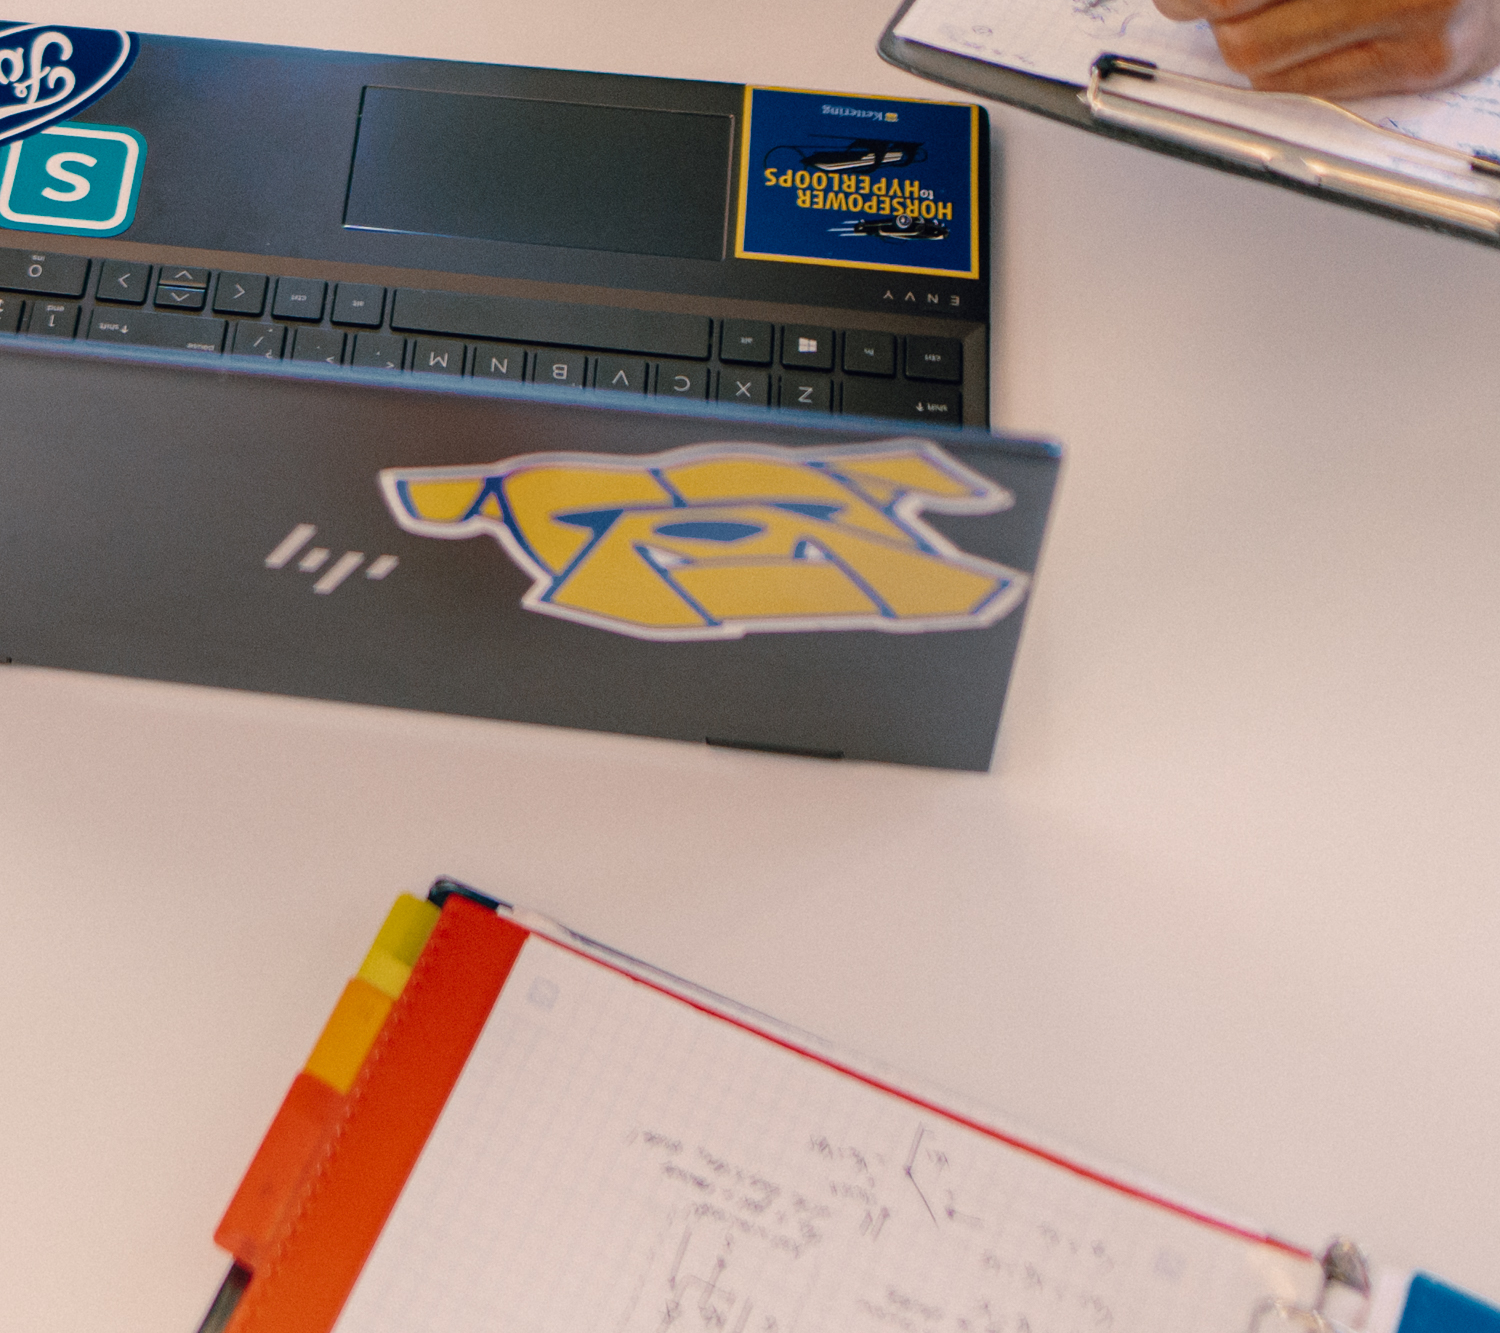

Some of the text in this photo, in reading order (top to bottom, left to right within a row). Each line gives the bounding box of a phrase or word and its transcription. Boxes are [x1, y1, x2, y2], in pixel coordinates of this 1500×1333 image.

[822, 104, 883, 122] Kettering
[41, 152, 97, 202] S
[764, 168, 934, 200] to HYPERLOOPS
[796, 190, 952, 220] HORSEPOWER
[883, 290, 960, 306] ENVY
[428, 351, 448, 368] M
[490, 357, 508, 374] N
[552, 363, 568, 380] B
[612, 369, 629, 386] V
[673, 375, 690, 392] C
[735, 381, 751, 398] X
[798, 386, 813, 403] Z
